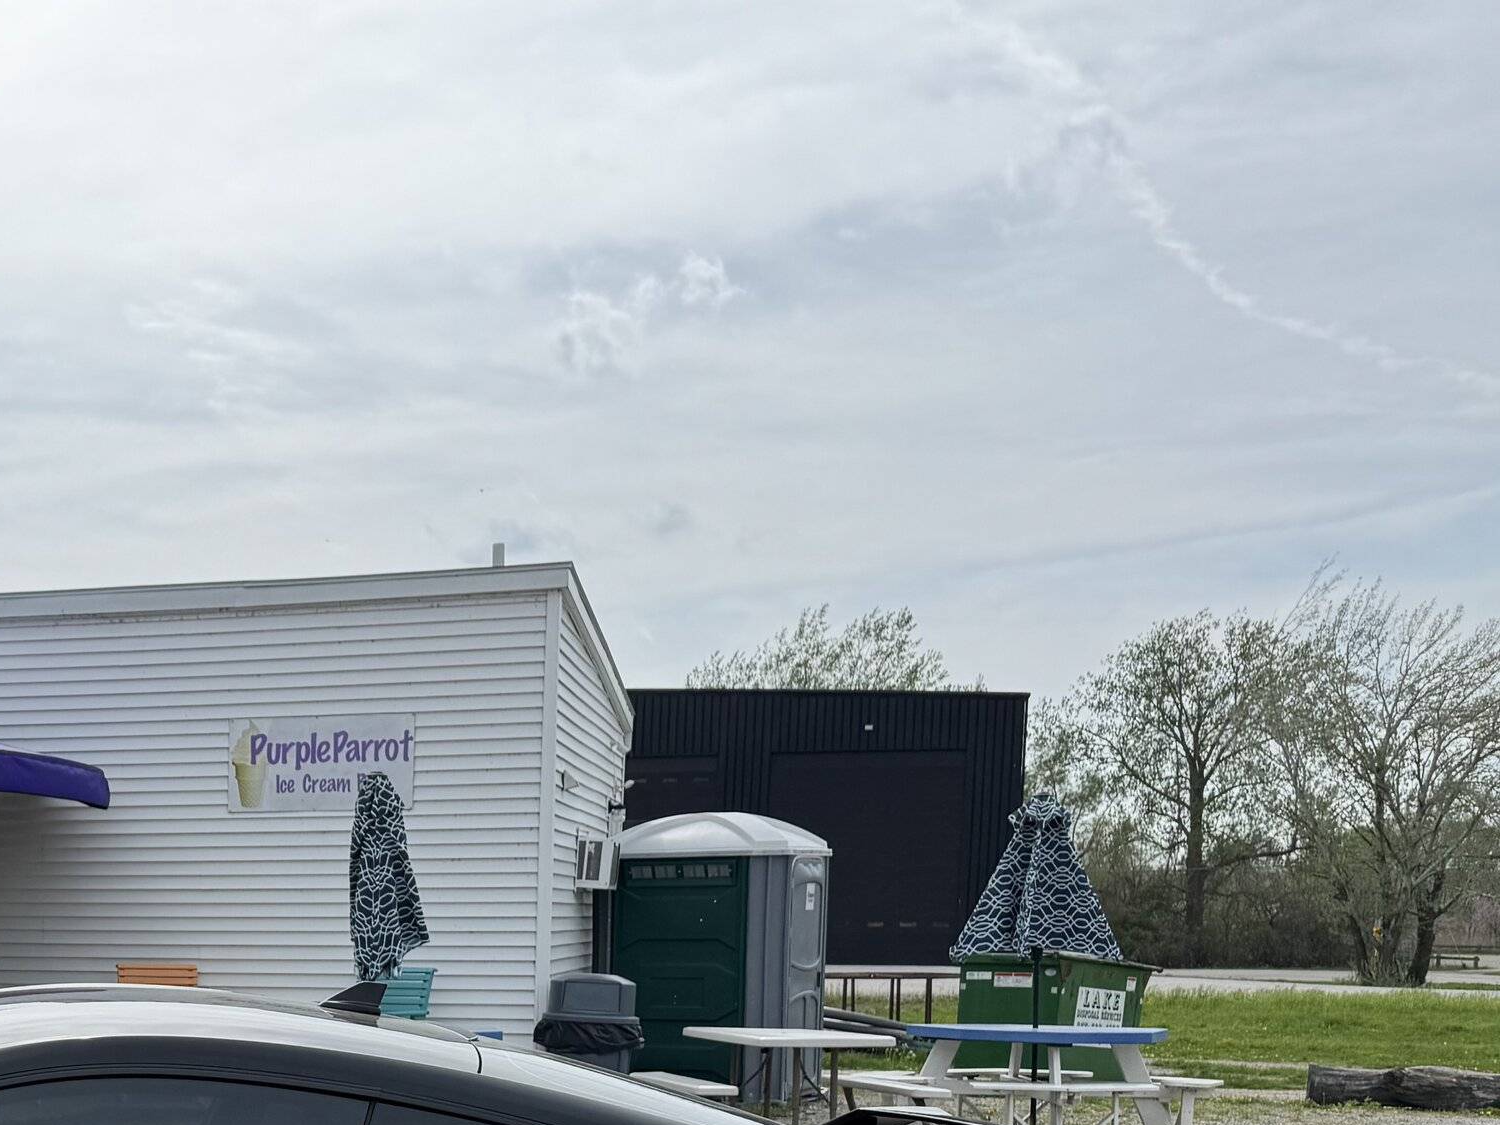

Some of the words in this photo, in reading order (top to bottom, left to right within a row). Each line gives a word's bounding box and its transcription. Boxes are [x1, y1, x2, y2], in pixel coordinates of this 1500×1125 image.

[275, 774, 295, 793] Ice
[302, 773, 351, 793] Cream
[1082, 989, 1121, 1011] LAKE
